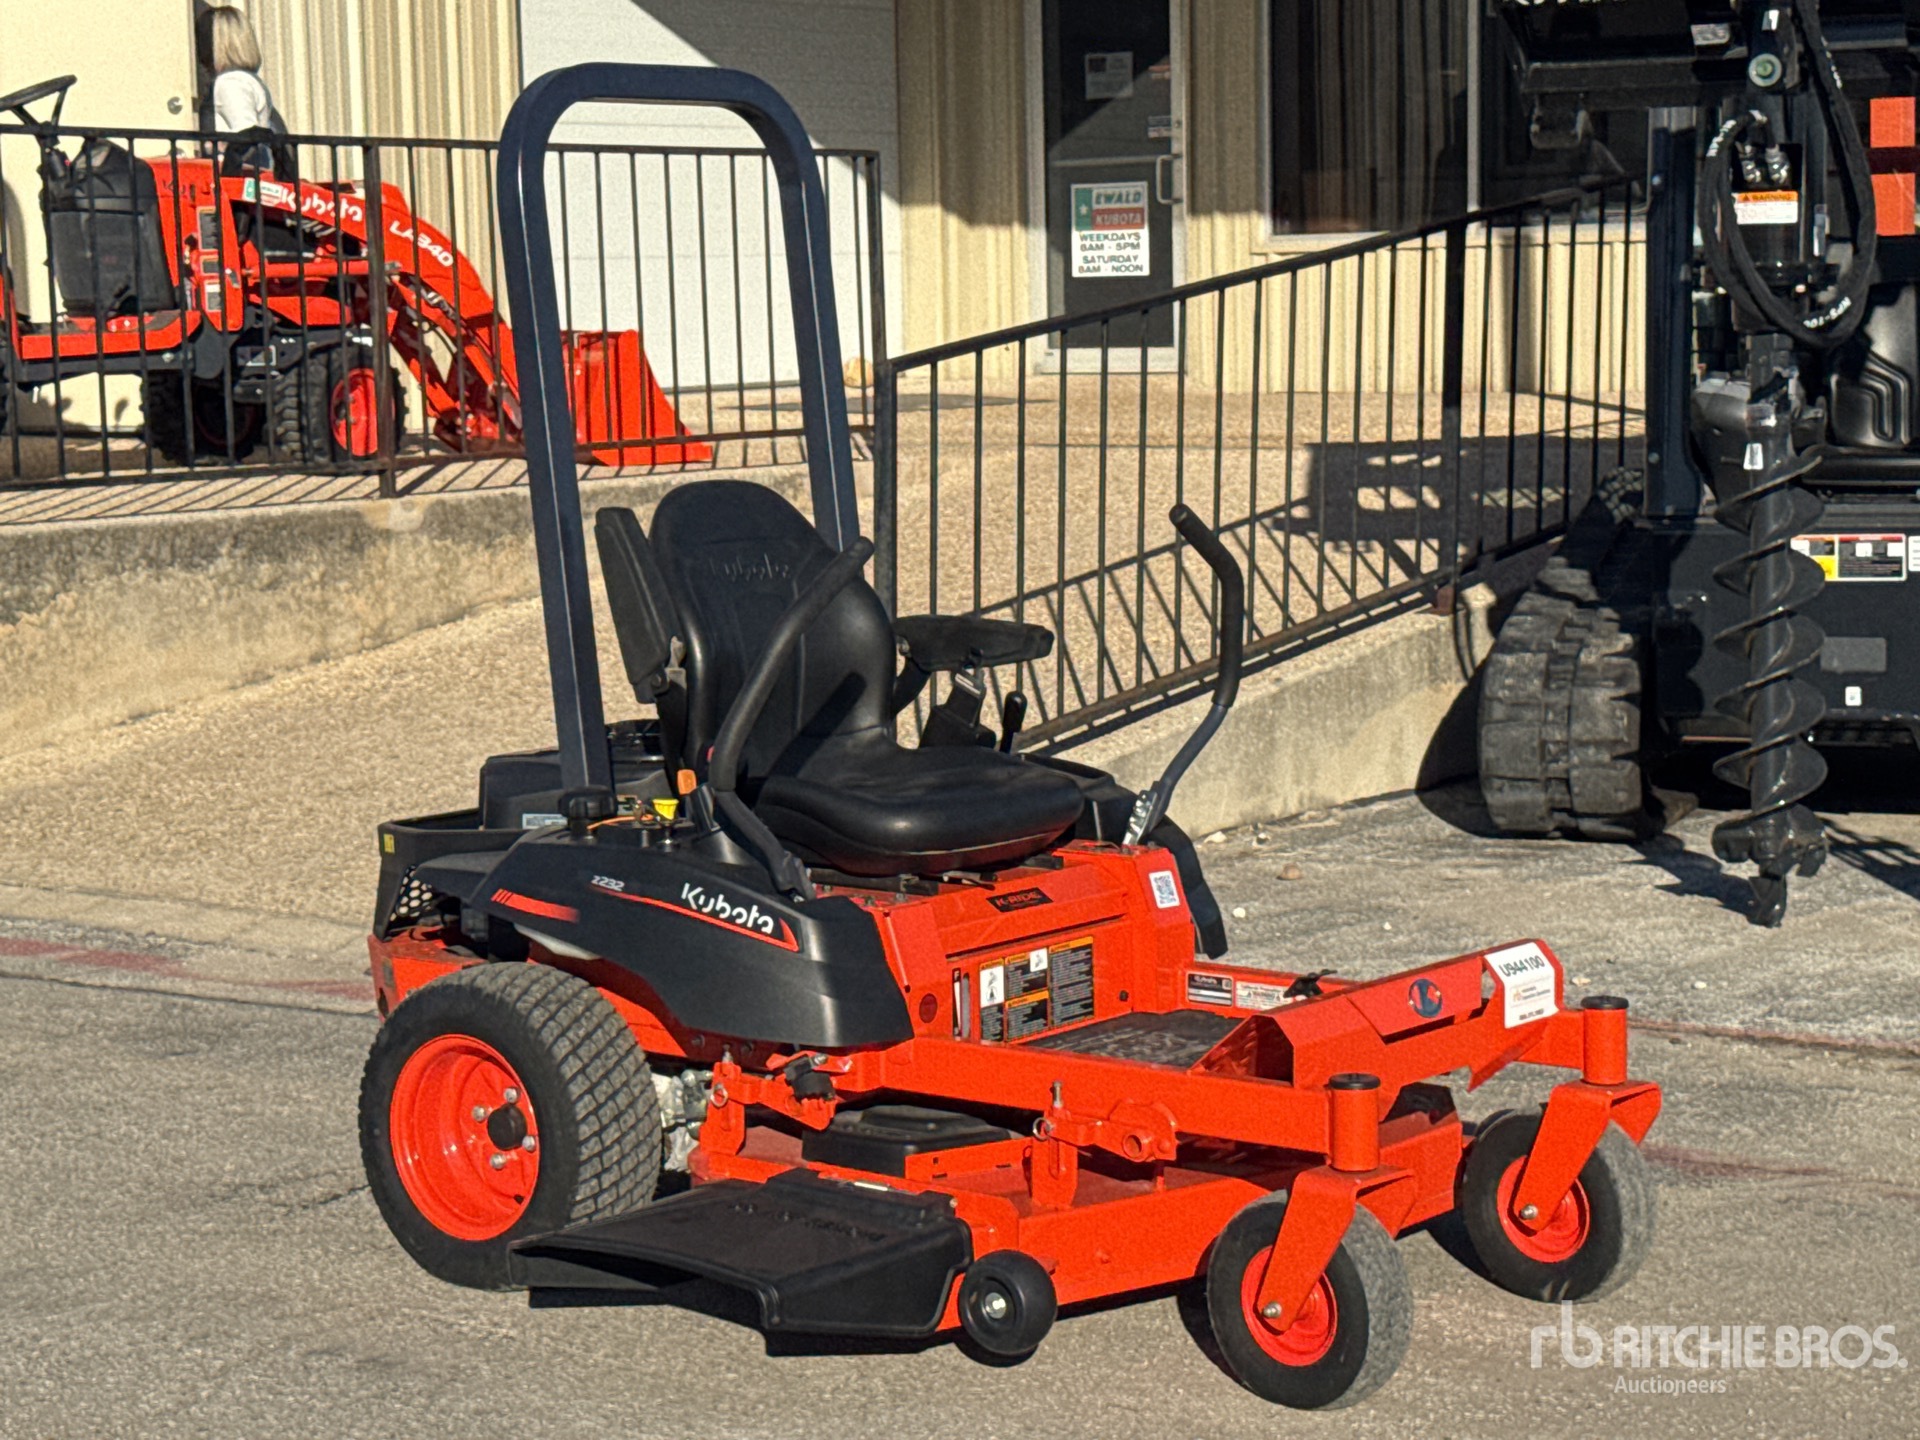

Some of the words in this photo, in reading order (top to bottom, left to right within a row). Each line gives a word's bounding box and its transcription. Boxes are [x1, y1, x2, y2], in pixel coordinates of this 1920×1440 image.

[1095, 189, 1142, 205] EWALD
[1095, 212, 1142, 226] KUBOTA
[1079, 231, 1142, 242] WEEKDAYS
[1082, 254, 1139, 264] SATURDAY
[1111, 263, 1144, 273] NOON
[681, 882, 774, 935] Kubota
